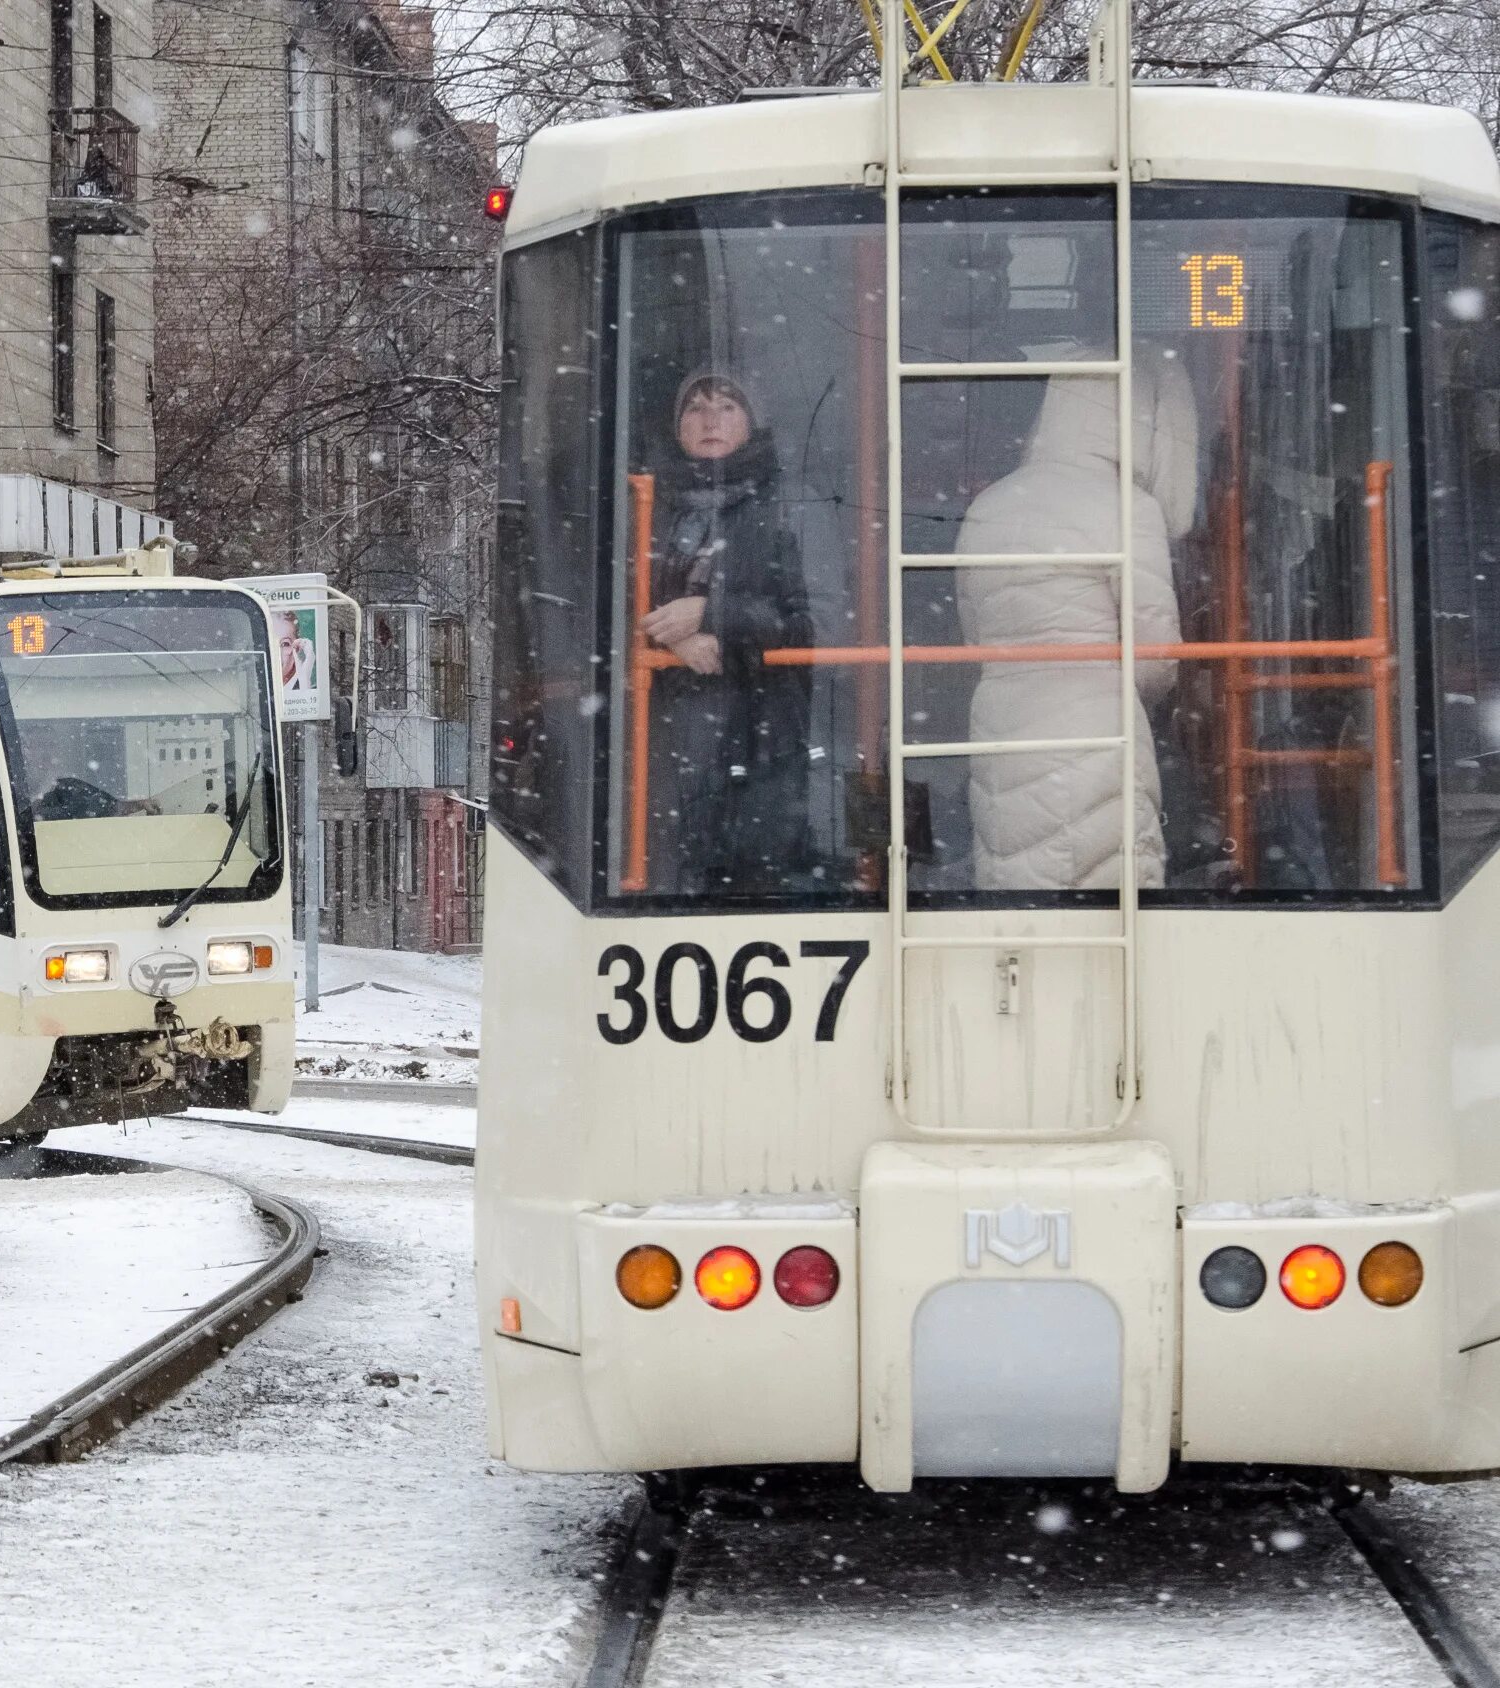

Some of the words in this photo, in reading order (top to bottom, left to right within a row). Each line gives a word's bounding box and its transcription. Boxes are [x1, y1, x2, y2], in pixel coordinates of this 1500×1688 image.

[1180, 254, 1243, 327] 13
[263, 590, 300, 601] ение
[7, 615, 44, 654] 13
[597, 940, 870, 1045] 3067
